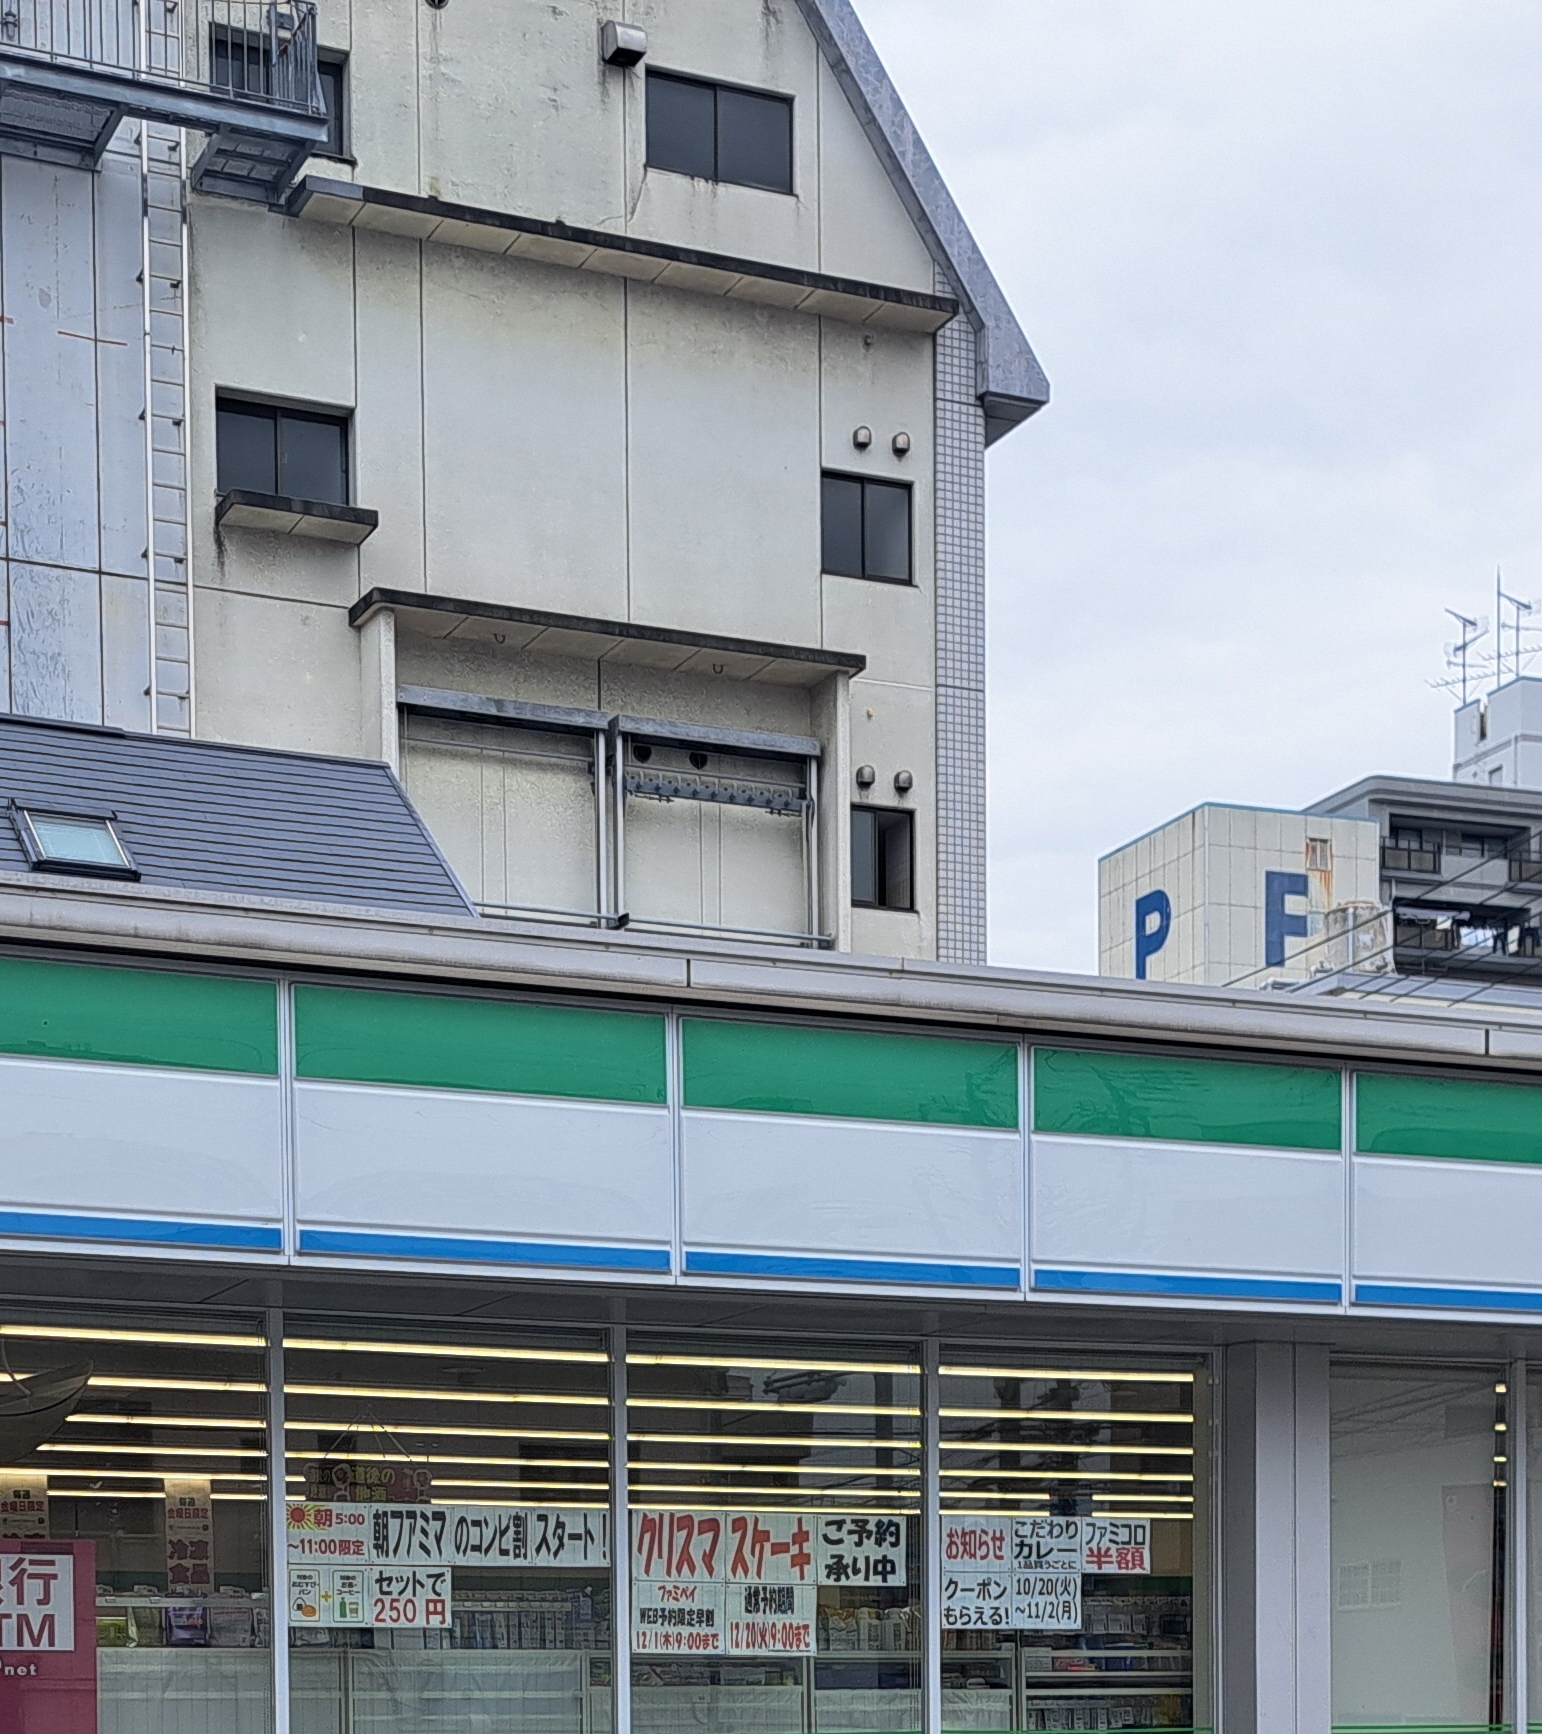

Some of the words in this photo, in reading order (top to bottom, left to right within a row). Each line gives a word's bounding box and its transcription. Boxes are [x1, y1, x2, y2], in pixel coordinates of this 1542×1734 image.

[1265, 870, 1308, 968] F
[1135, 889, 1172, 980] P
[821, 1518, 901, 1549] ご予約
[1013, 1519, 1079, 1540] こだわり
[1085, 1522, 1146, 1546] ファミコロ
[945, 1527, 1006, 1561] お知らせ
[1014, 1539, 1078, 1560] カレー
[825, 1554, 896, 1583] 承り中
[1085, 1546, 1146, 1571] 半額
[375, 1570, 447, 1598] セットで
[657, 1585, 698, 1603] ファミペイ
[944, 1578, 1008, 1600] クーポン
[1015, 1576, 1078, 1600] 10/20(火)
[943, 1604, 1009, 1627] もらえる!
